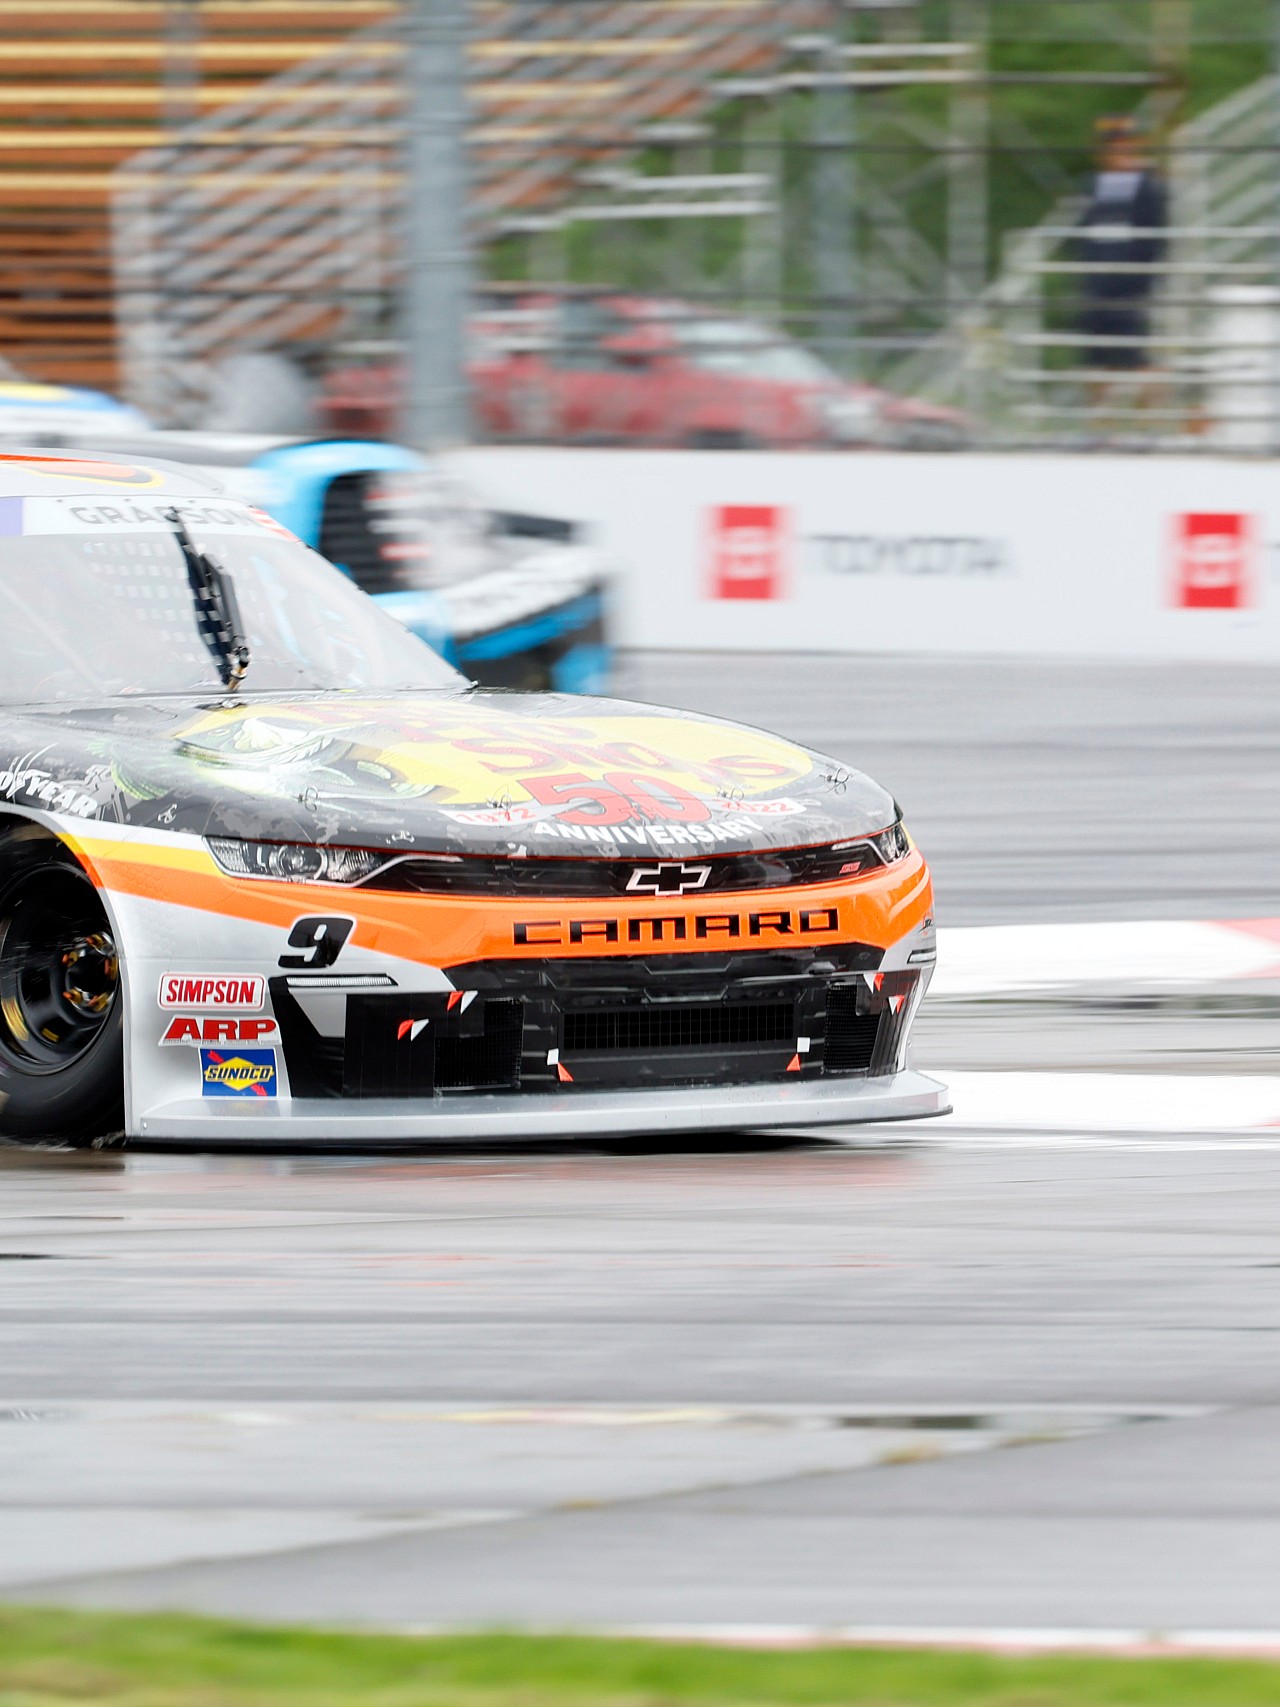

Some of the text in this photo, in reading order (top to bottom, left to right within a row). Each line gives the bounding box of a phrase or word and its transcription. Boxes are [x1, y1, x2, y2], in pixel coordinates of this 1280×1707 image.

[517, 773, 713, 826] 50
[534, 816, 766, 845] ANNIVERSARY
[513, 908, 839, 945] CAMARO
[277, 916, 355, 969] 9
[166, 980, 256, 1003] SIMPSON
[164, 1018, 277, 1040] ARP
[206, 1066, 272, 1080] SUNOCO
